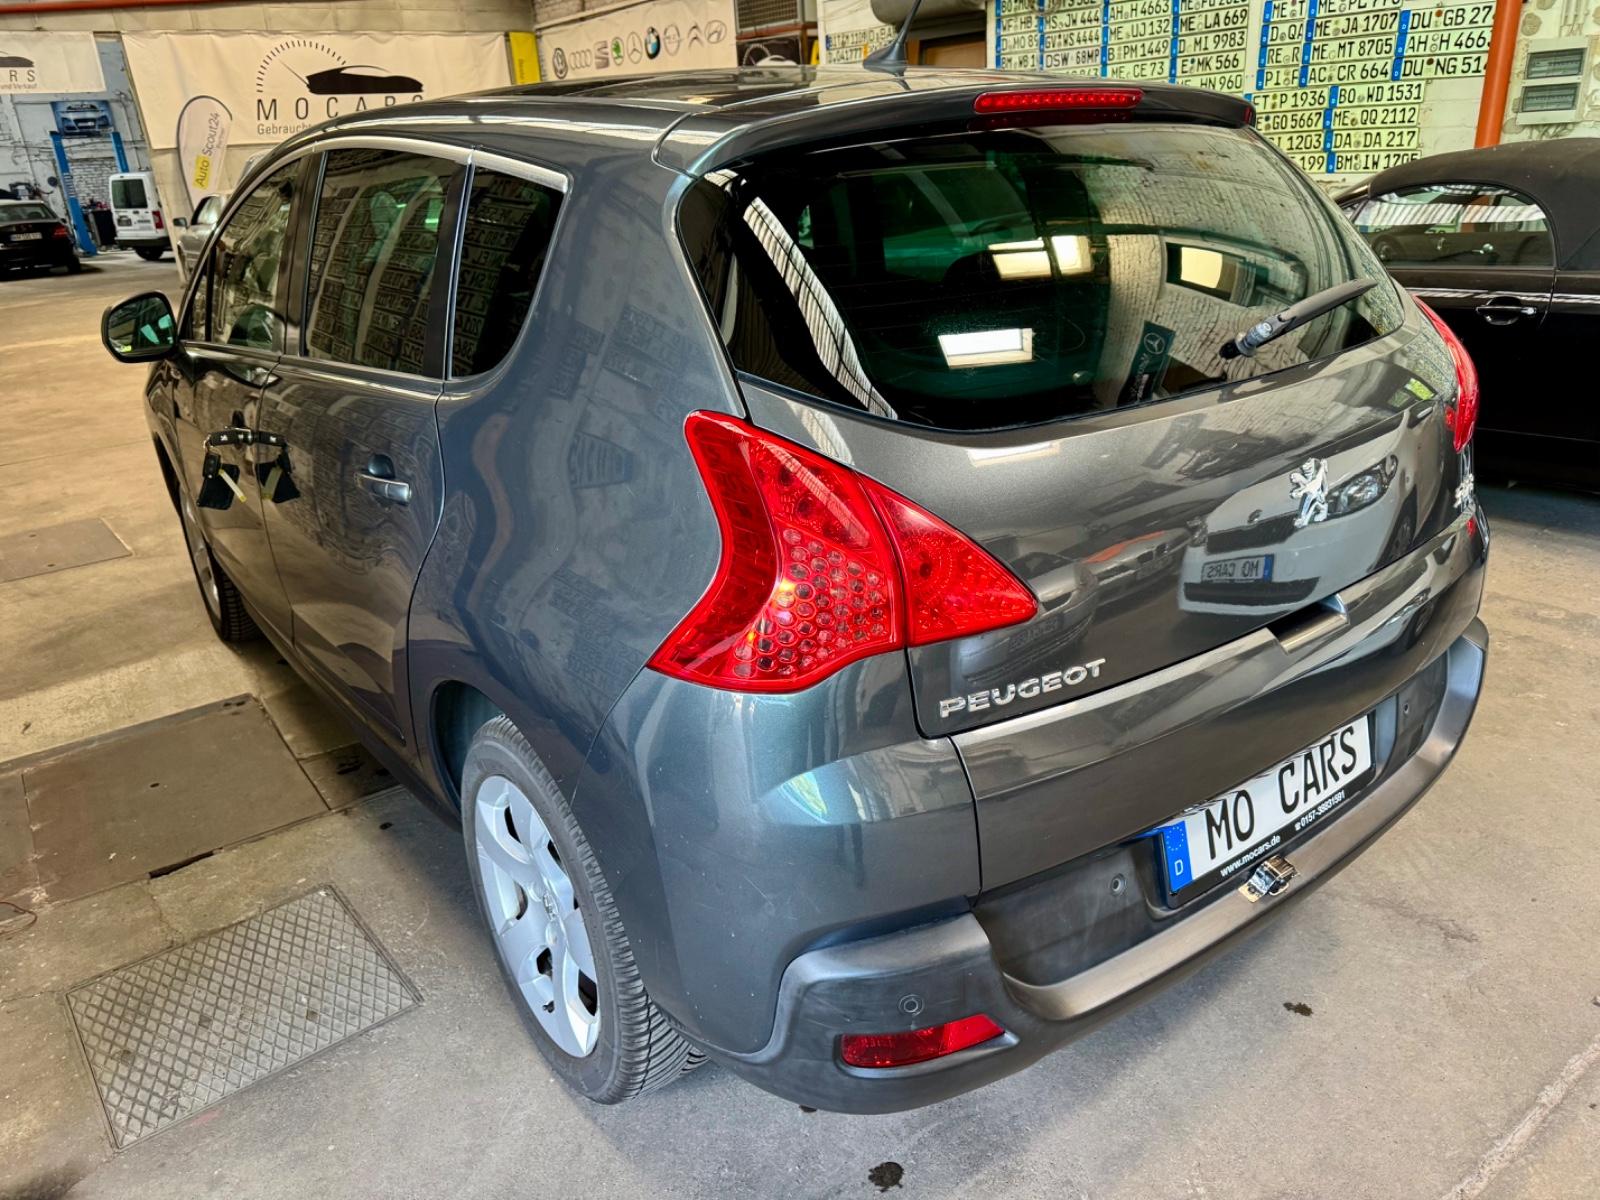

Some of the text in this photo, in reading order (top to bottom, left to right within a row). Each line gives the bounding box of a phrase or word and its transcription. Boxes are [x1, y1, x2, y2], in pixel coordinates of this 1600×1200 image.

[1081, 10, 1100, 24] 444
[1110, 5, 1124, 20] AH
[1131, 4, 1138, 18] H
[1140, 1, 1170, 15] 4663
[1180, 9, 1248, 31] ME LA 669
[1273, 3, 1288, 19] ME
[1410, 12, 1432, 30] DU
[1443, 8, 1466, 27] GB
[1468, 5, 1496, 25] 27
[1109, 18, 1170, 41] ME UJ 132
[1270, 26, 1280, 42] D
[1315, 12, 1398, 38] ME JA 1707
[1076, 29, 1100, 45] 4444
[1179, 31, 1246, 54] D MI 9983
[1407, 36, 1429, 53] AH
[1439, 33, 1451, 51] H
[1454, 30, 1491, 49] 466
[1108, 40, 1169, 61] B PM 1449
[1267, 48, 1283, 65] RE
[1311, 38, 1393, 61] ME MT 8705
[1045, 54, 1069, 68] DSW
[1111, 65, 1125, 79] ME
[1133, 63, 1148, 78] CE
[1150, 61, 1165, 76] 73
[1181, 53, 1240, 74] E MK 566
[1402, 60, 1425, 78] DU
[1434, 57, 1458, 76] NG
[1460, 55, 1487, 74] 51
[1219, 74, 1243, 91] 960
[1264, 70, 1281, 87] PI
[1309, 61, 1390, 84] AC CR 664
[1280, 93, 1288, 108] P
[1292, 91, 1326, 108] 1936
[1339, 83, 1422, 104] BO WD 1531
[256, 94, 424, 121] MOCA
[1333, 107, 1417, 128] ME QQ 2112
[1272, 114, 1288, 131] GO
[1290, 111, 1323, 129] 5667
[202, 112, 221, 157] Scout24
[1287, 134, 1323, 151] 1203
[1334, 130, 1417, 150] DA DA 217
[1301, 154, 1326, 172] 199
[1336, 155, 1354, 172] BM
[1363, 153, 1381, 171] IW
[195, 160, 210, 188] Auto
[938, 657, 1107, 719] PEUGEOT
[1174, 725, 1358, 877] D MO CARS
[1220, 834, 1282, 878] www.mocars.de
